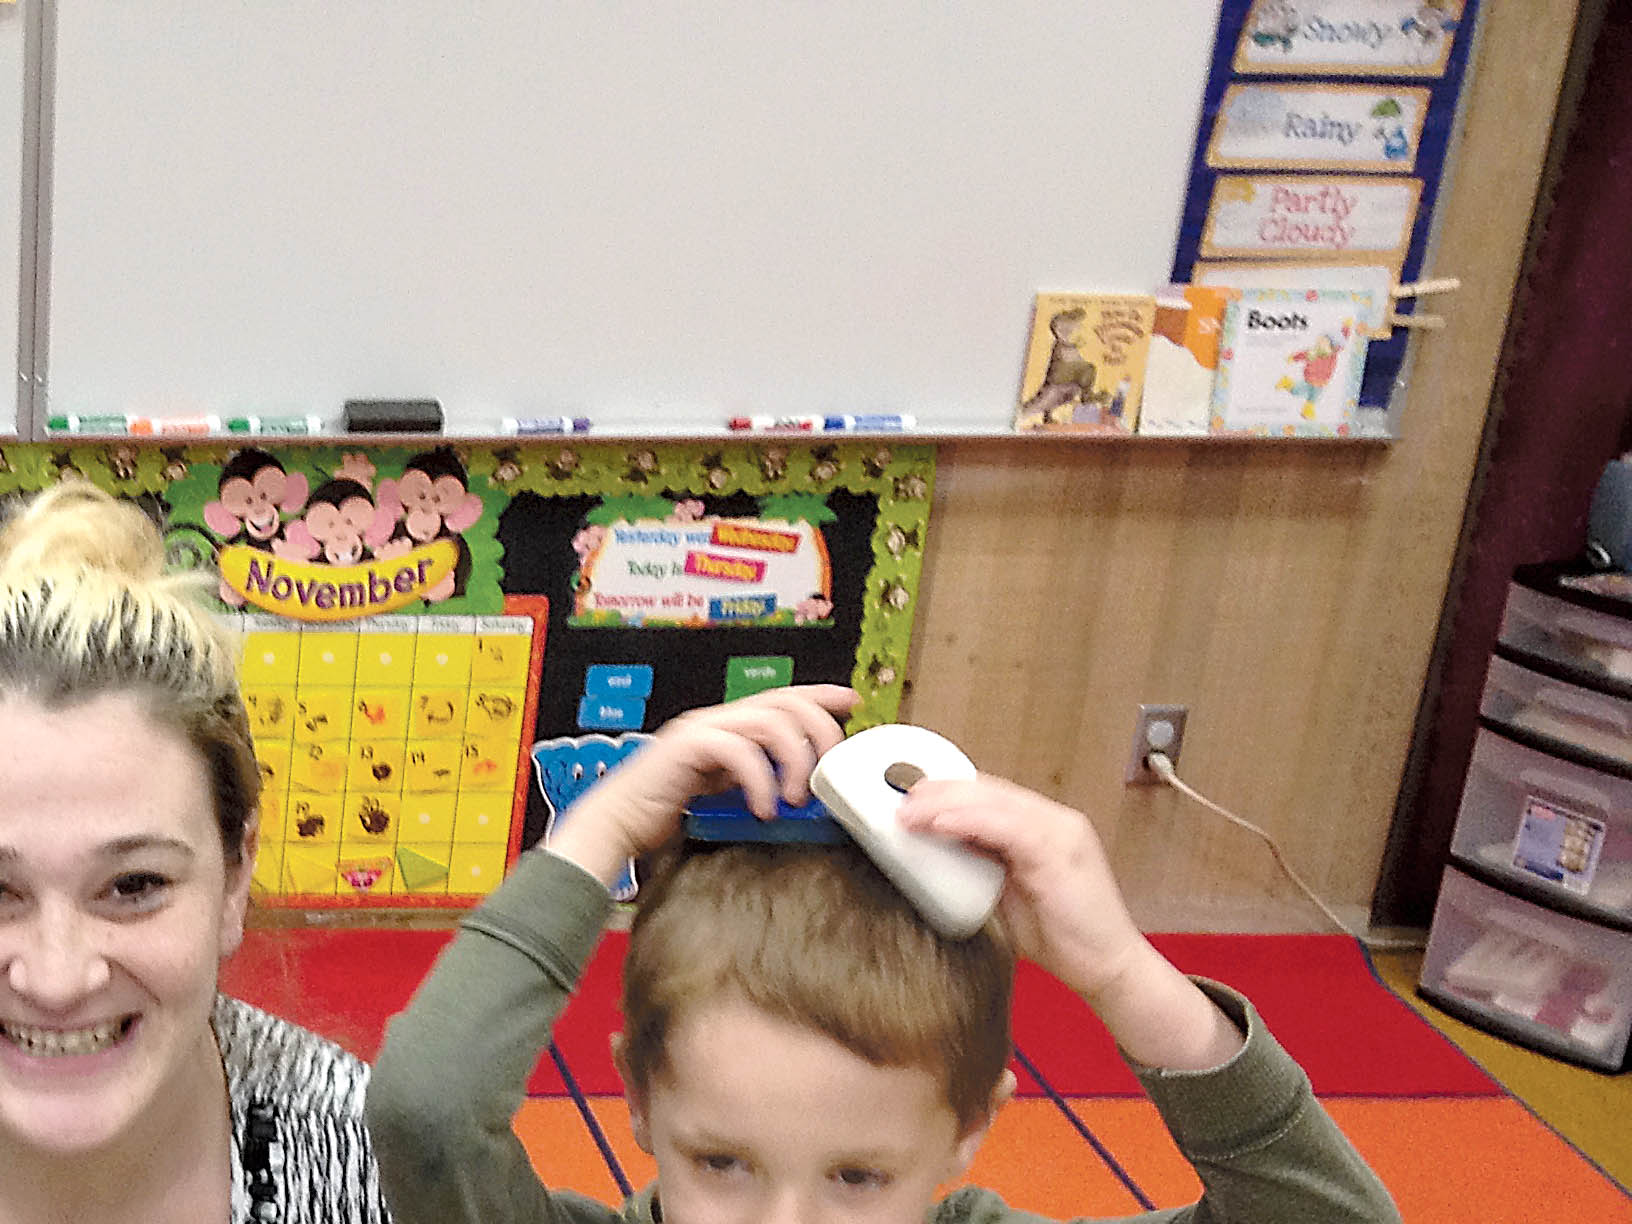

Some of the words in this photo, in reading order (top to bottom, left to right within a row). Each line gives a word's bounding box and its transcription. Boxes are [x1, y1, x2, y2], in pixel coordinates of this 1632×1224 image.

[1283, 111, 1362, 147] Rainy
[1270, 185, 1358, 221] Partly
[1258, 215, 1356, 250] Cloudy
[1245, 308, 1310, 333] Boots
[245, 556, 435, 610] November
[627, 561, 667, 581] Today
[593, 591, 655, 609] Tomorrow
